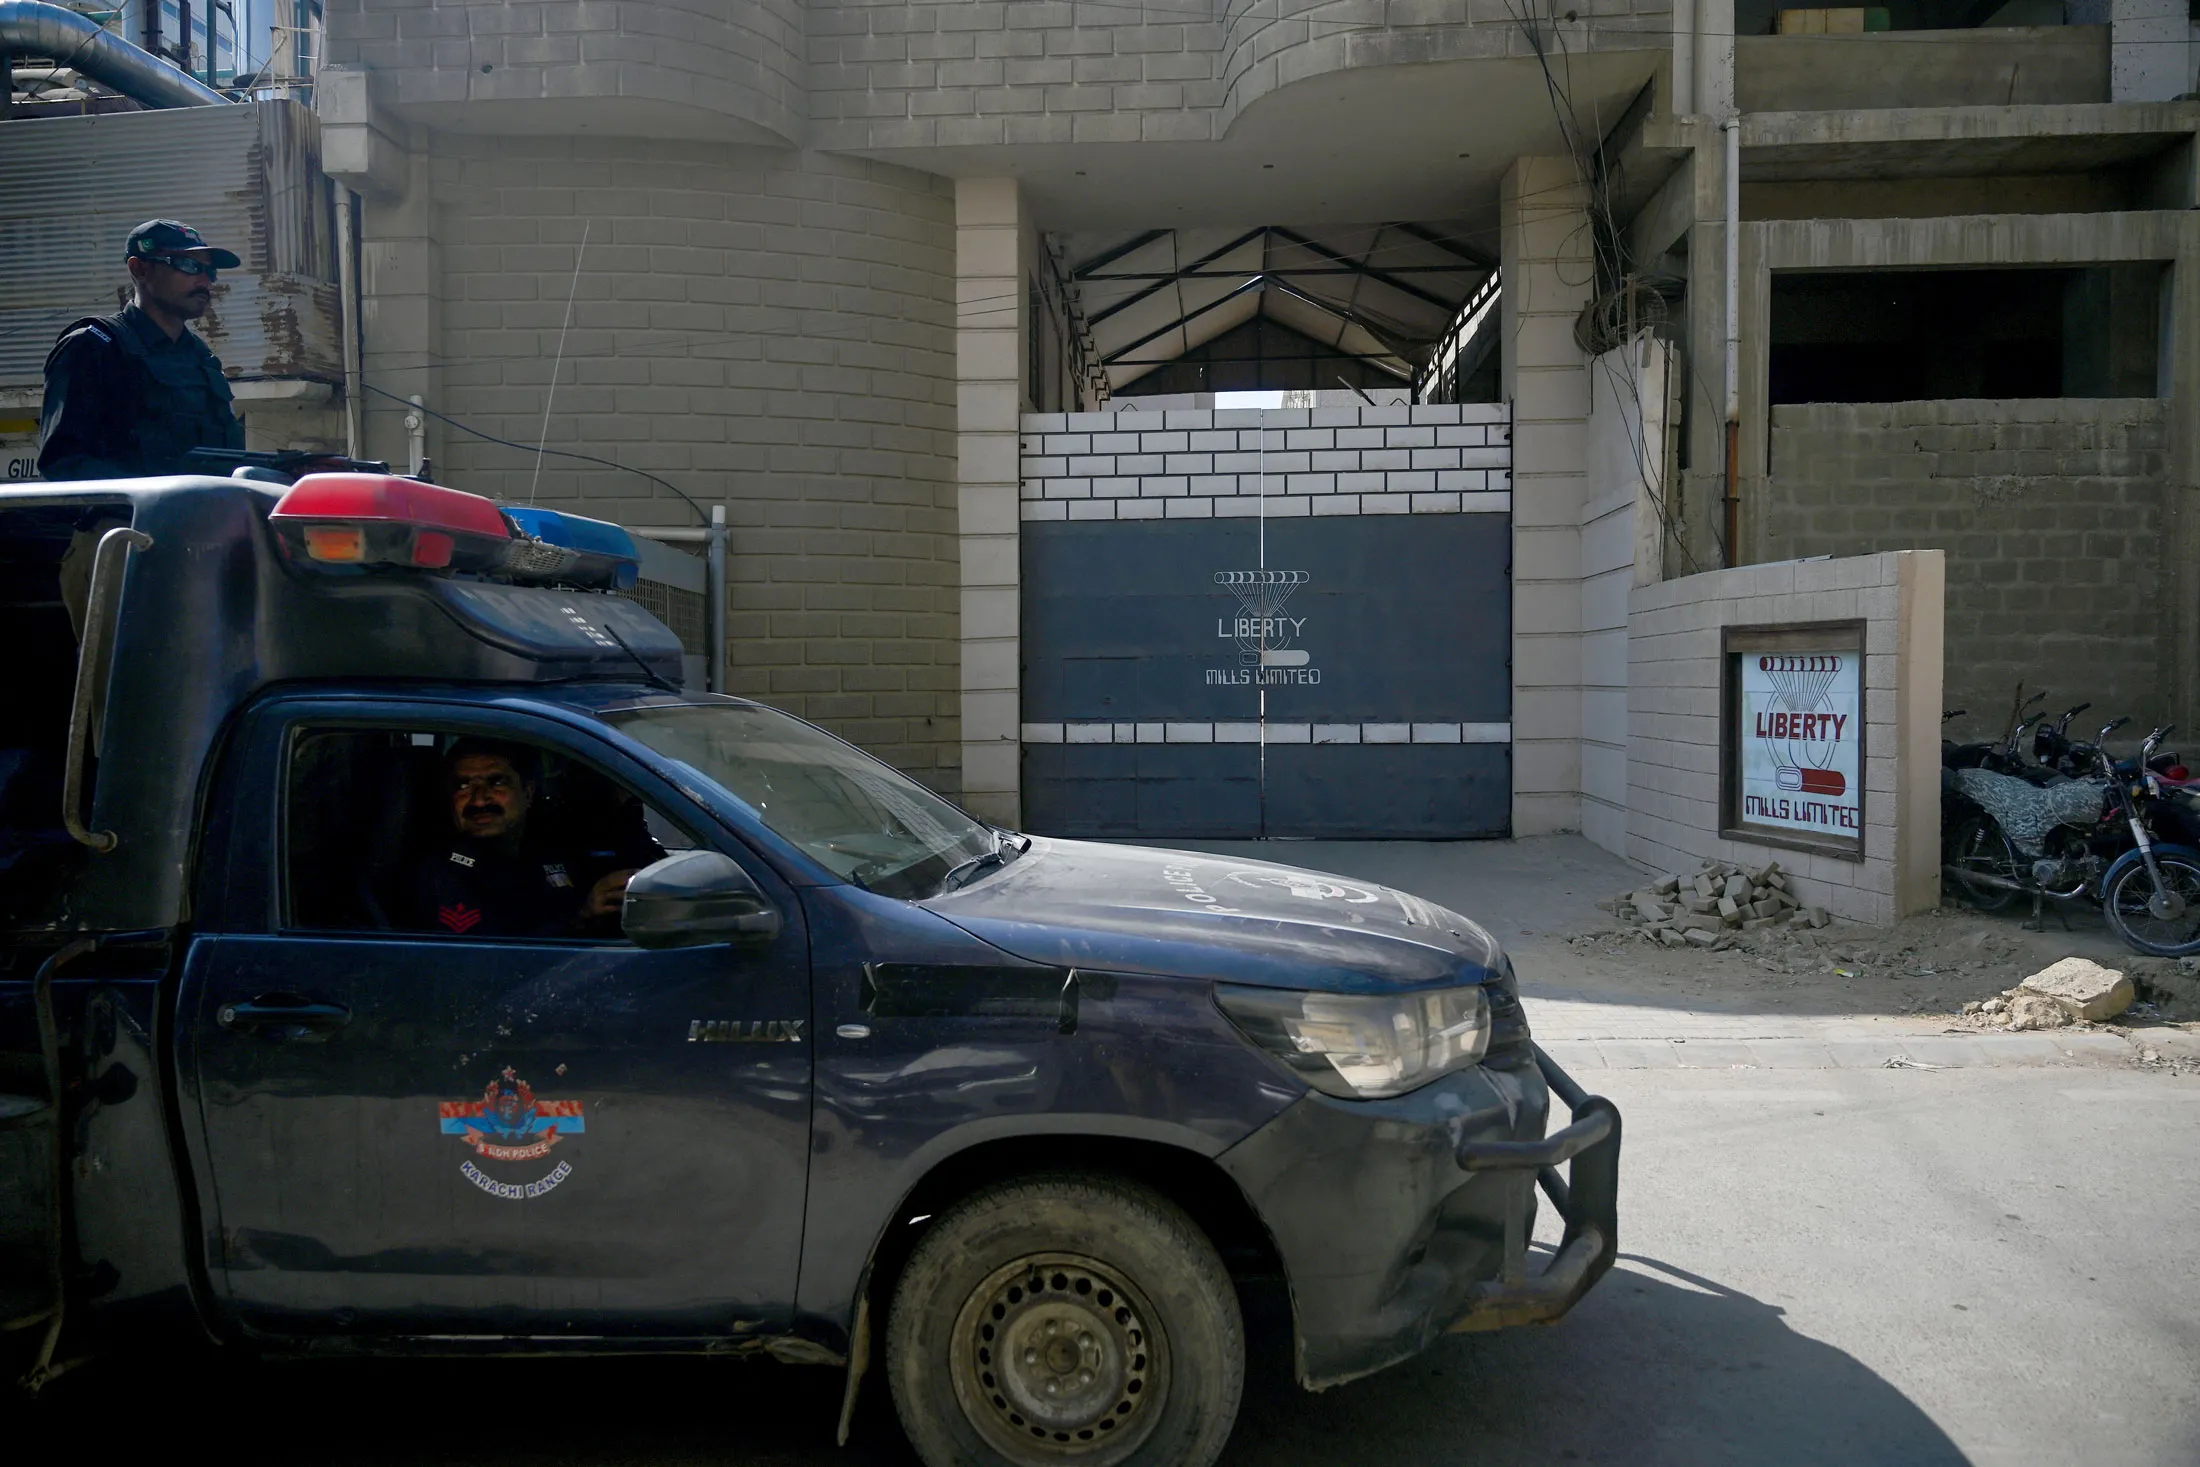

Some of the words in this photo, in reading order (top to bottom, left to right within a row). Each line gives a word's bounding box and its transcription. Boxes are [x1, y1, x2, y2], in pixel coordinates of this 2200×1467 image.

[8, 459, 41, 478] GUL
[1218, 617, 1307, 638] LIBERTY
[1206, 668, 1250, 685] MILLS
[1255, 668, 1321, 685] LIMITED
[1756, 711, 1847, 742] LIBERTY
[1745, 795, 1790, 820] MILLS
[1163, 869, 1241, 911] POLICE
[688, 1019, 804, 1041] HILUX
[478, 1143, 510, 1158] SNDH
[512, 1144, 549, 1158] POLICE
[460, 1160, 524, 1199] KARACHI
[526, 1160, 573, 1199] RANGE
